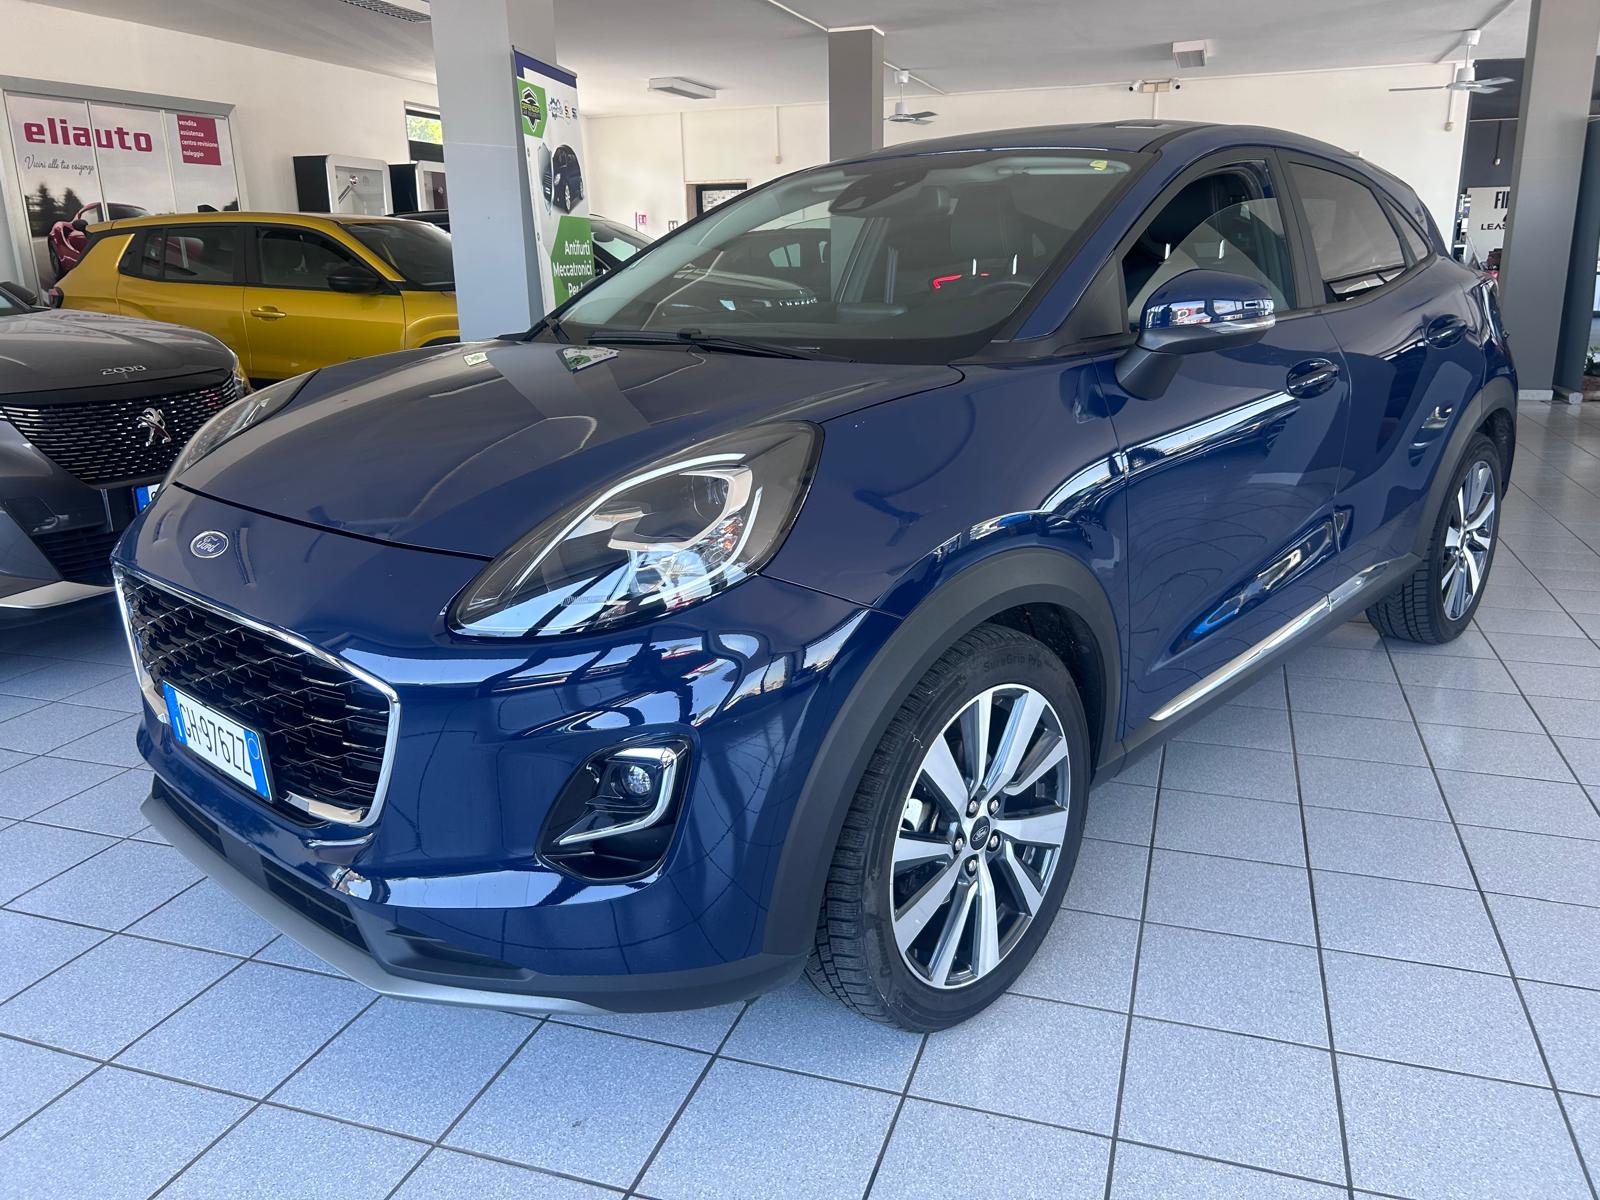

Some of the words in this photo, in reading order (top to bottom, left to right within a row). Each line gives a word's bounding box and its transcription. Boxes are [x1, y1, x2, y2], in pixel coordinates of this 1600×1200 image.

[24, 117, 153, 153] eliauto
[183, 150, 205, 158] noleggio
[47, 159, 59, 169] alle
[564, 239, 591, 256] Antifurti
[552, 260, 593, 277] Meccatronici
